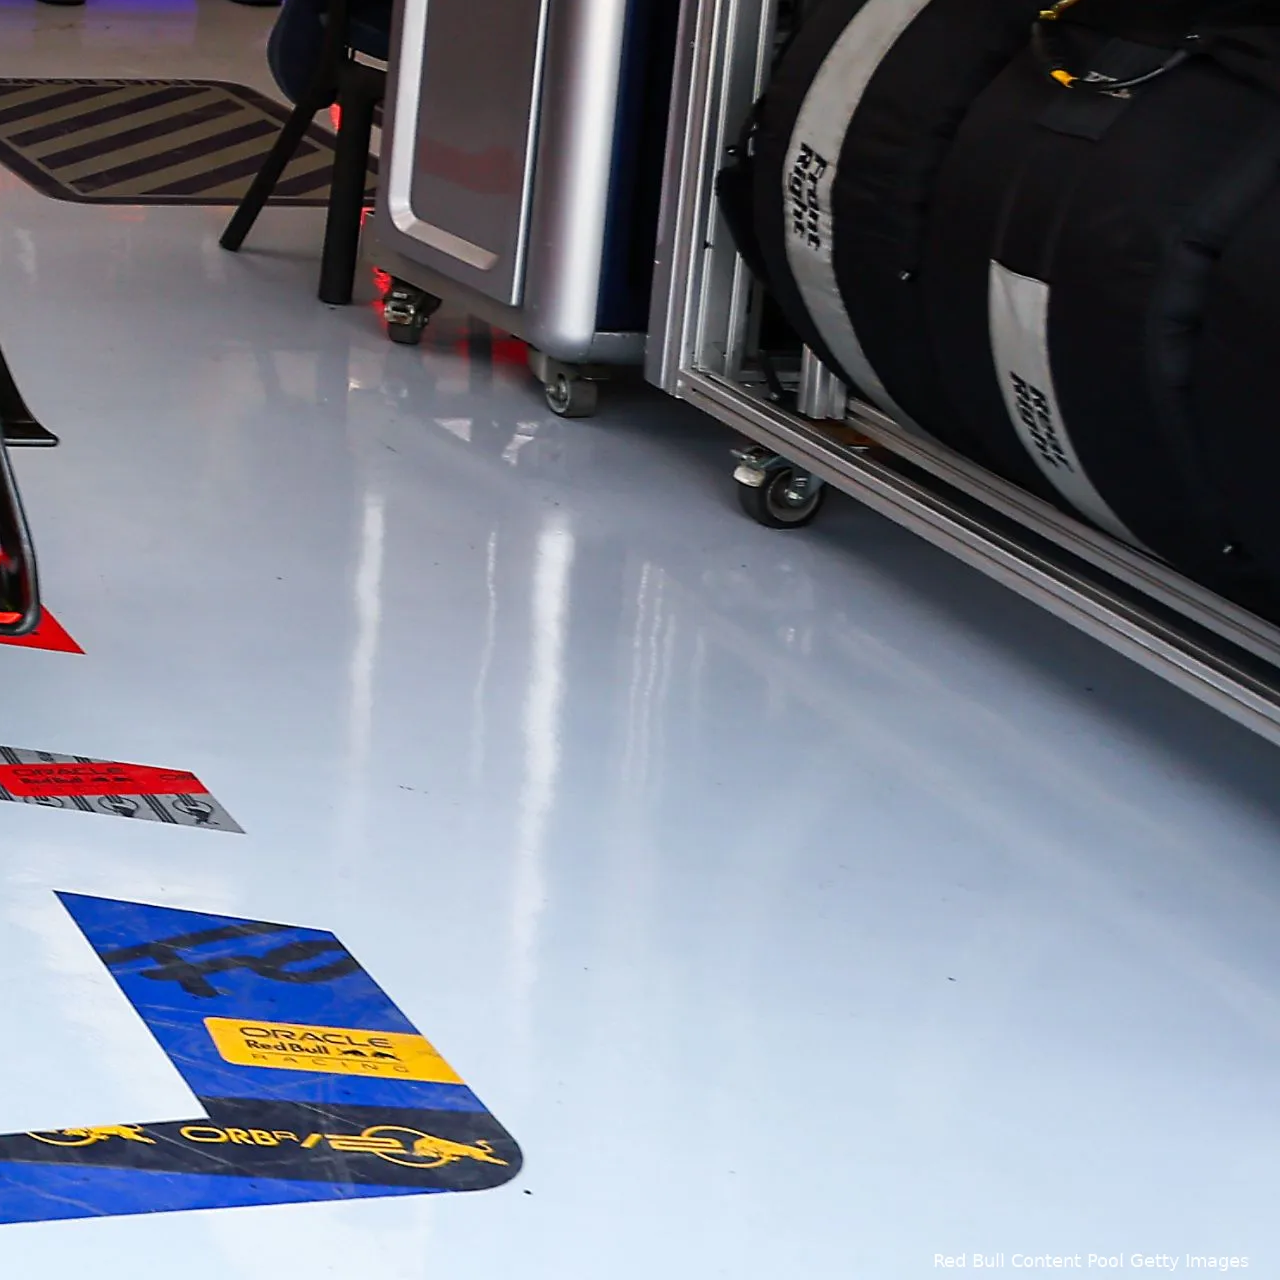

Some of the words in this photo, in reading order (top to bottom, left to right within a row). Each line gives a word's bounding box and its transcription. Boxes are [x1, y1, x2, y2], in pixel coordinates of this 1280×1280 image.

[239, 1026, 394, 1049] ORACLE
[245, 1039, 288, 1053] Red
[289, 1042, 330, 1056] Bull
[251, 1053, 410, 1074] RACING
